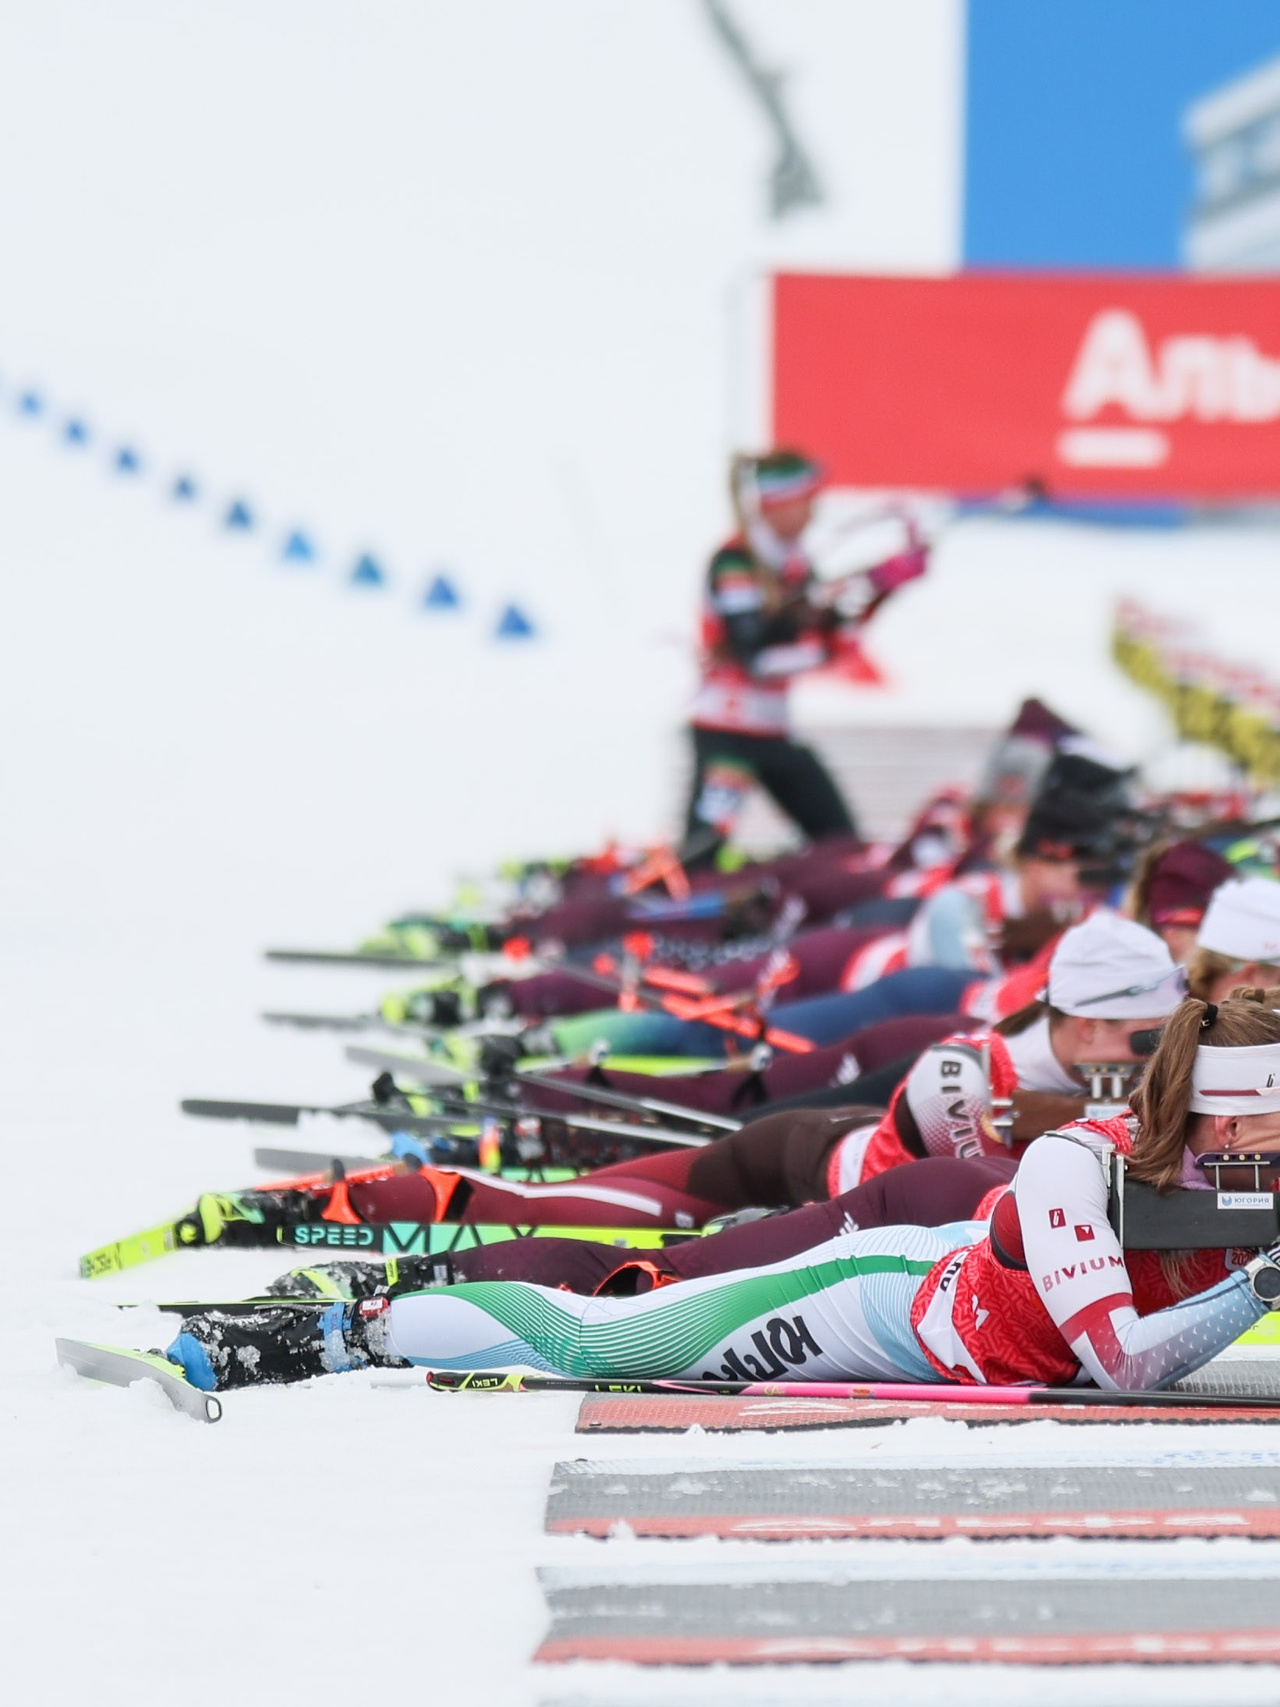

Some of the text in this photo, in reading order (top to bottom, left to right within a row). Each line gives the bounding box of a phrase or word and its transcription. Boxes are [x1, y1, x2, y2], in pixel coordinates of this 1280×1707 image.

[941, 1061, 983, 1159] BIVIU
[294, 1225, 375, 1246] SPEED
[1042, 1256, 1124, 1293] BIVIUM
[472, 1377, 498, 1388] LEKI
